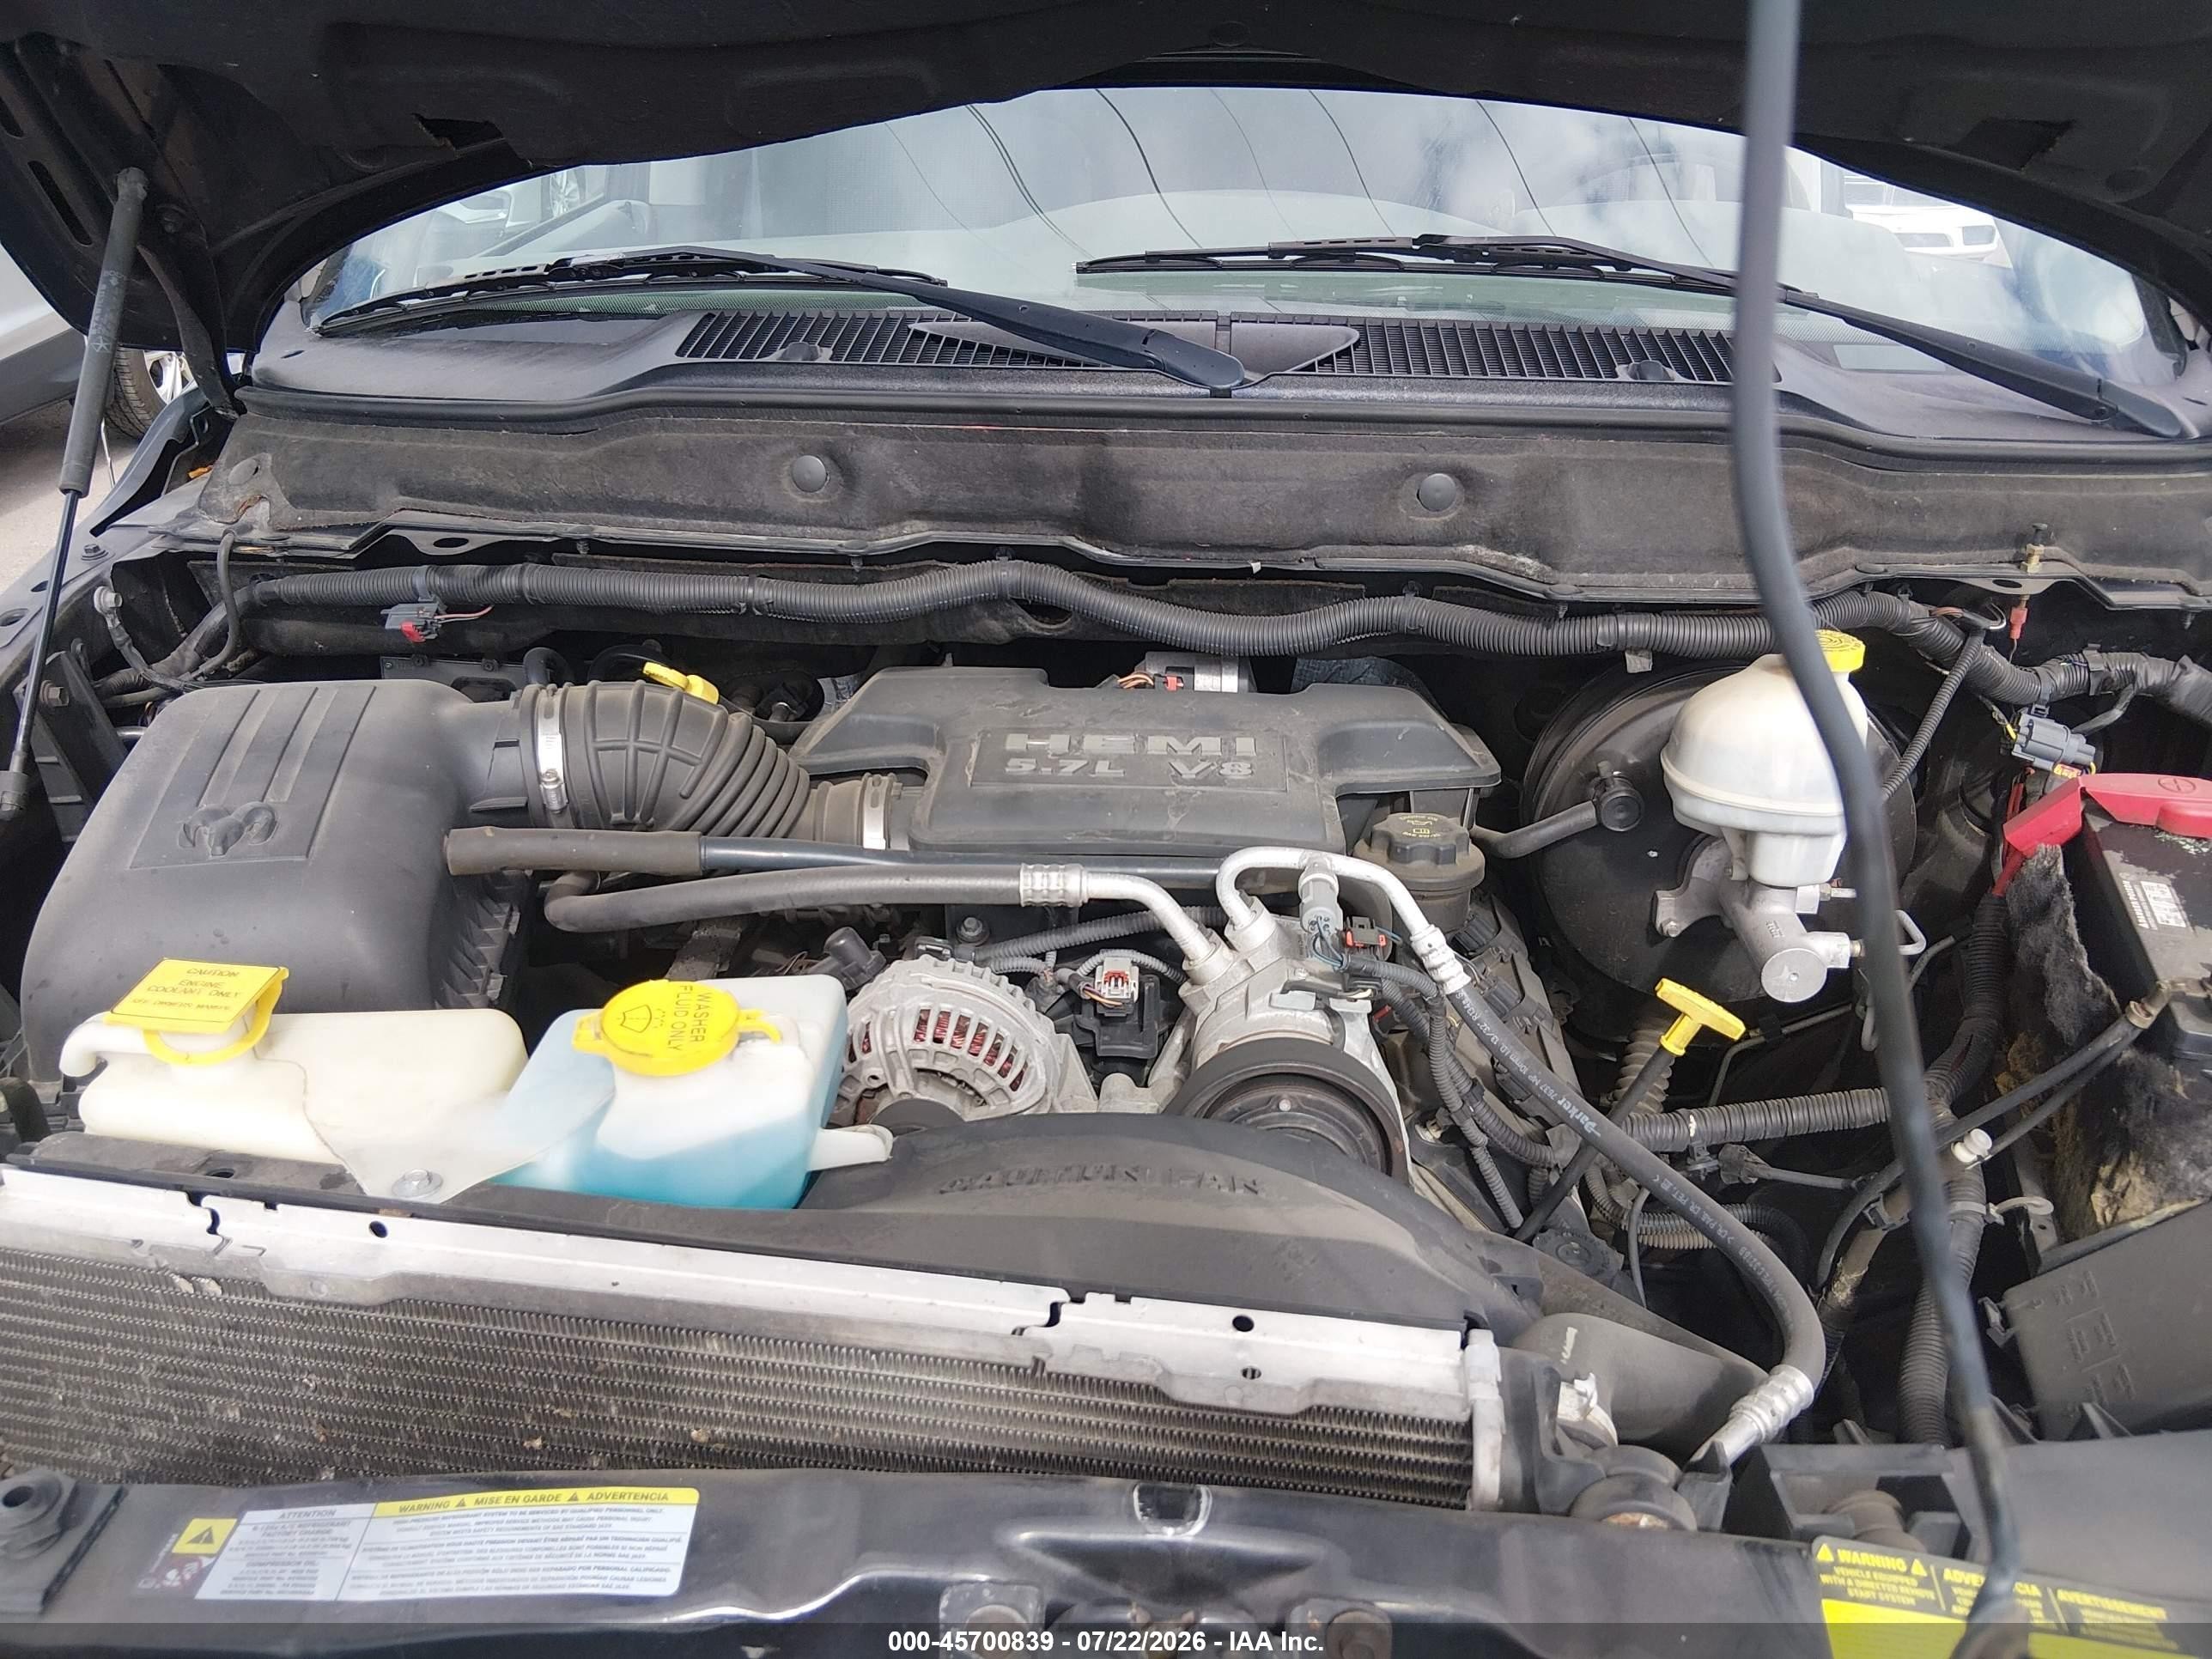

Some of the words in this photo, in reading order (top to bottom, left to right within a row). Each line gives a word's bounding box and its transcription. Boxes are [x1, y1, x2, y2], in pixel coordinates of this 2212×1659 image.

[1005, 733, 1258, 757] HEMI
[1004, 757, 1127, 778] 5.7L
[1168, 760, 1255, 779] V8
[179, 979, 225, 989] ENGINE
[186, 967, 240, 978] CAUTION
[147, 985, 203, 995] COOLANT
[209, 989, 242, 998] ONLY
[673, 985, 694, 1018] FLUID
[690, 992, 714, 1042] WASHER
[666, 1021, 687, 1052] ONLY
[398, 1501, 451, 1514] WARNING
[473, 1495, 502, 1506] MISE
[503, 1494, 520, 1504] EN
[522, 1492, 562, 1504] GARDE
[586, 1491, 669, 1502] ADVERTENCIA
[278, 1509, 337, 1520] ATTENTION
[1837, 1548, 1908, 1573] WARNING
